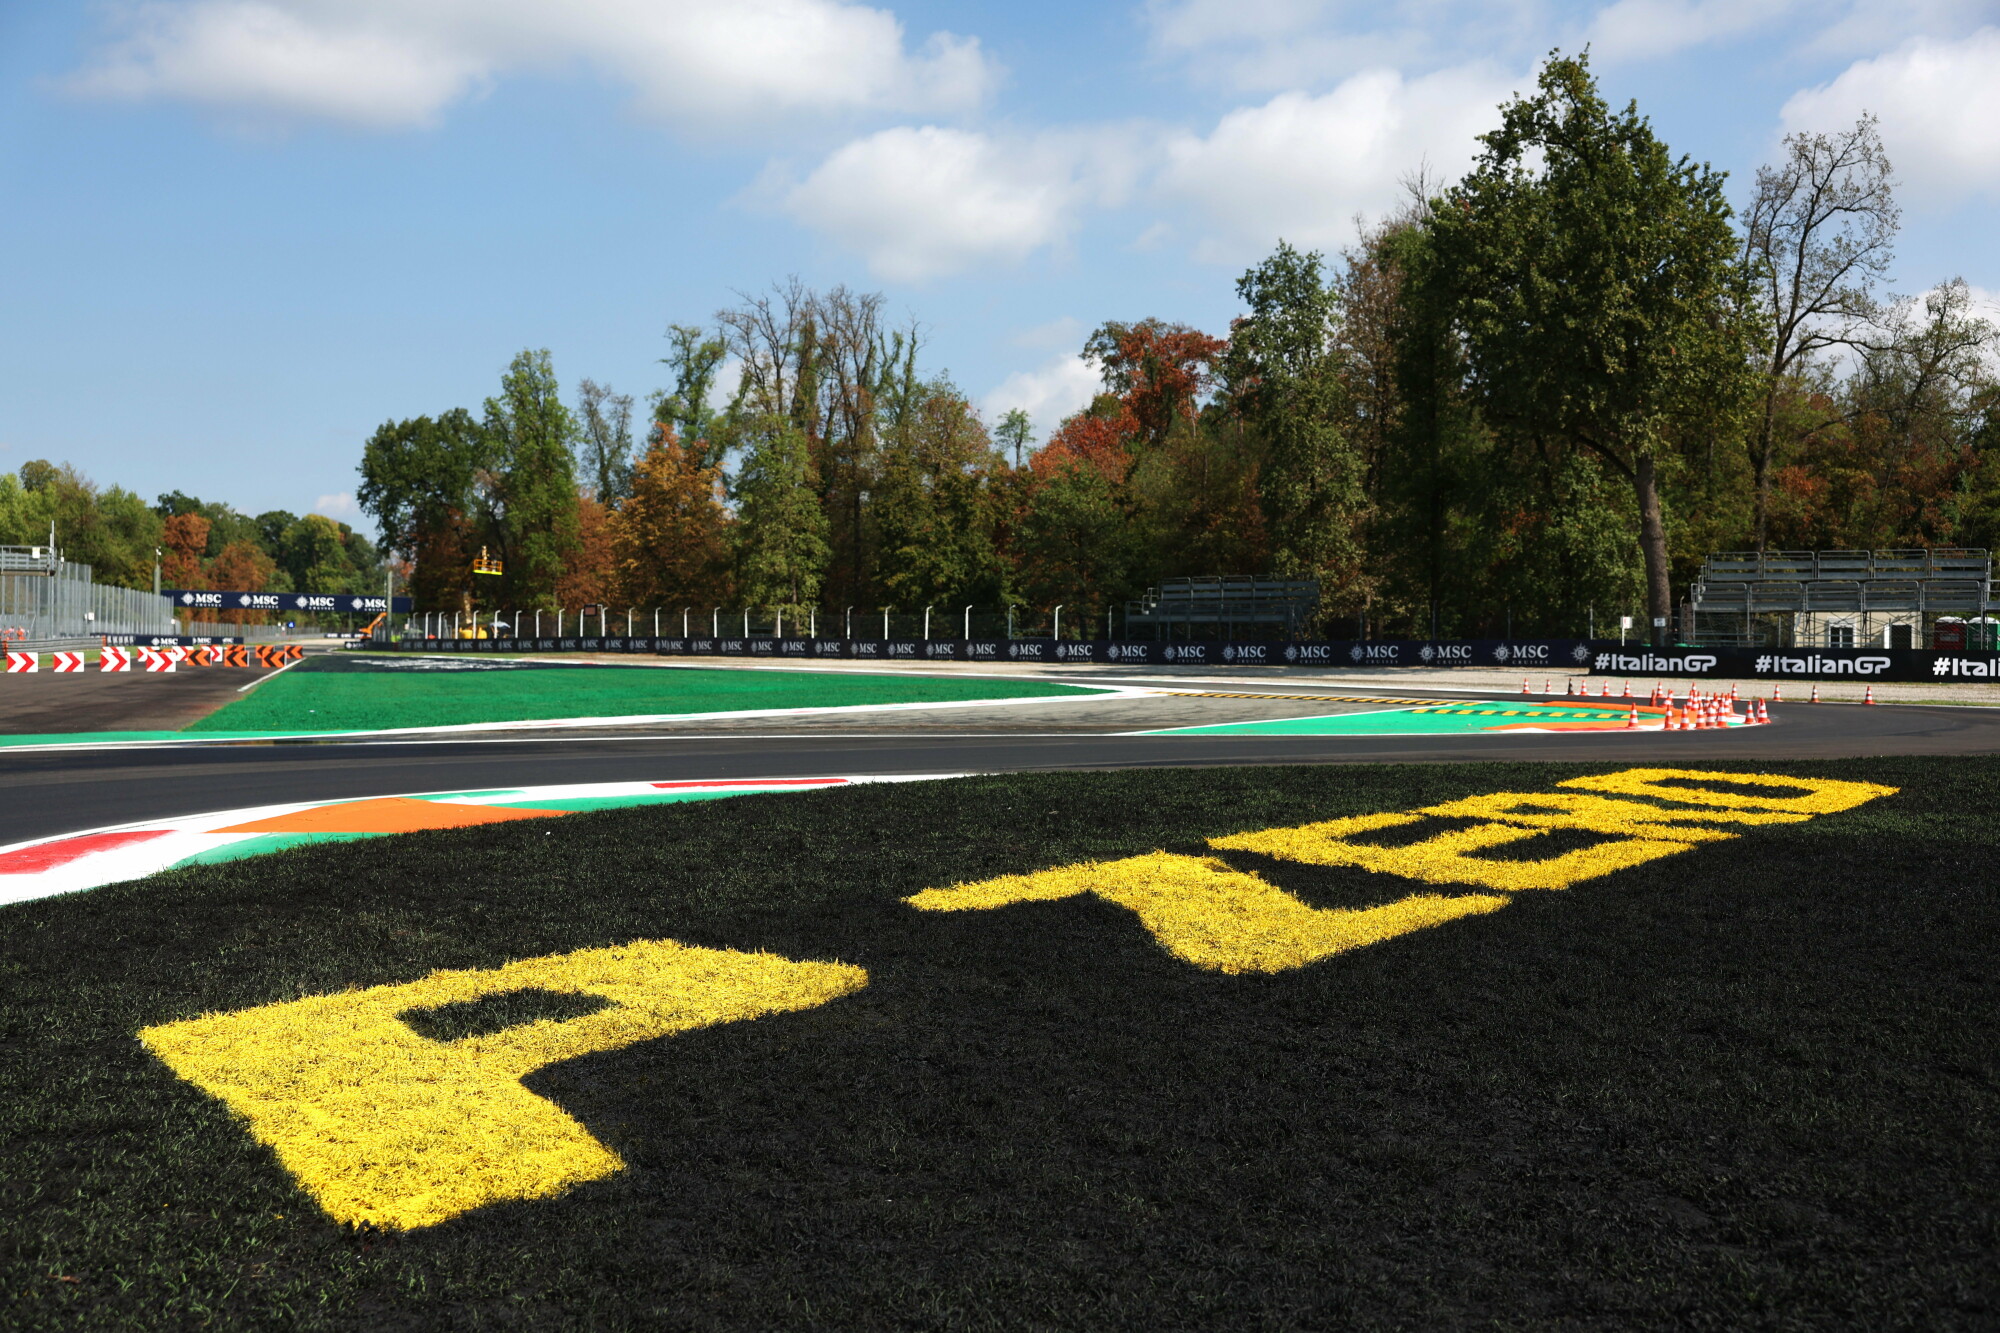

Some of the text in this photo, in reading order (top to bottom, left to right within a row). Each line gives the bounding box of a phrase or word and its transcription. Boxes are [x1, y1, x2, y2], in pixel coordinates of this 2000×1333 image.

[195, 593, 222, 604] MSC
[252, 595, 279, 605] MSC
[308, 597, 335, 607] MSC
[364, 598, 387, 608] MSC
[160, 637, 179, 645] MSC
[587, 640, 598, 648] MSC
[610, 640, 622, 649] MSC
[635, 640, 648, 649] MSC
[670, 641, 684, 650] MSC
[698, 641, 712, 650] MSC
[727, 641, 743, 650] MSC
[758, 641, 773, 651] MSC
[789, 641, 806, 652] MSC
[823, 642, 840, 652] MSC
[859, 643, 877, 653] MSC
[896, 643, 915, 654] MSC
[935, 643, 954, 654] MSC
[976, 644, 996, 655] MSC
[1020, 644, 1042, 655] MSC
[1068, 645, 1093, 656] MSC
[1121, 645, 1147, 657] MSC
[1177, 646, 1206, 658] MSC
[1237, 646, 1267, 658] MSC
[1300, 645, 1331, 658] MSC
[1366, 645, 1399, 658] MSC
[1437, 645, 1472, 659] MSC
[1512, 645, 1549, 659] MSC
[1595, 653, 1717, 672] #ItalianGP
[1755, 655, 1891, 674] #ItalianGP
[138, 767, 1900, 1231] P ZERO
